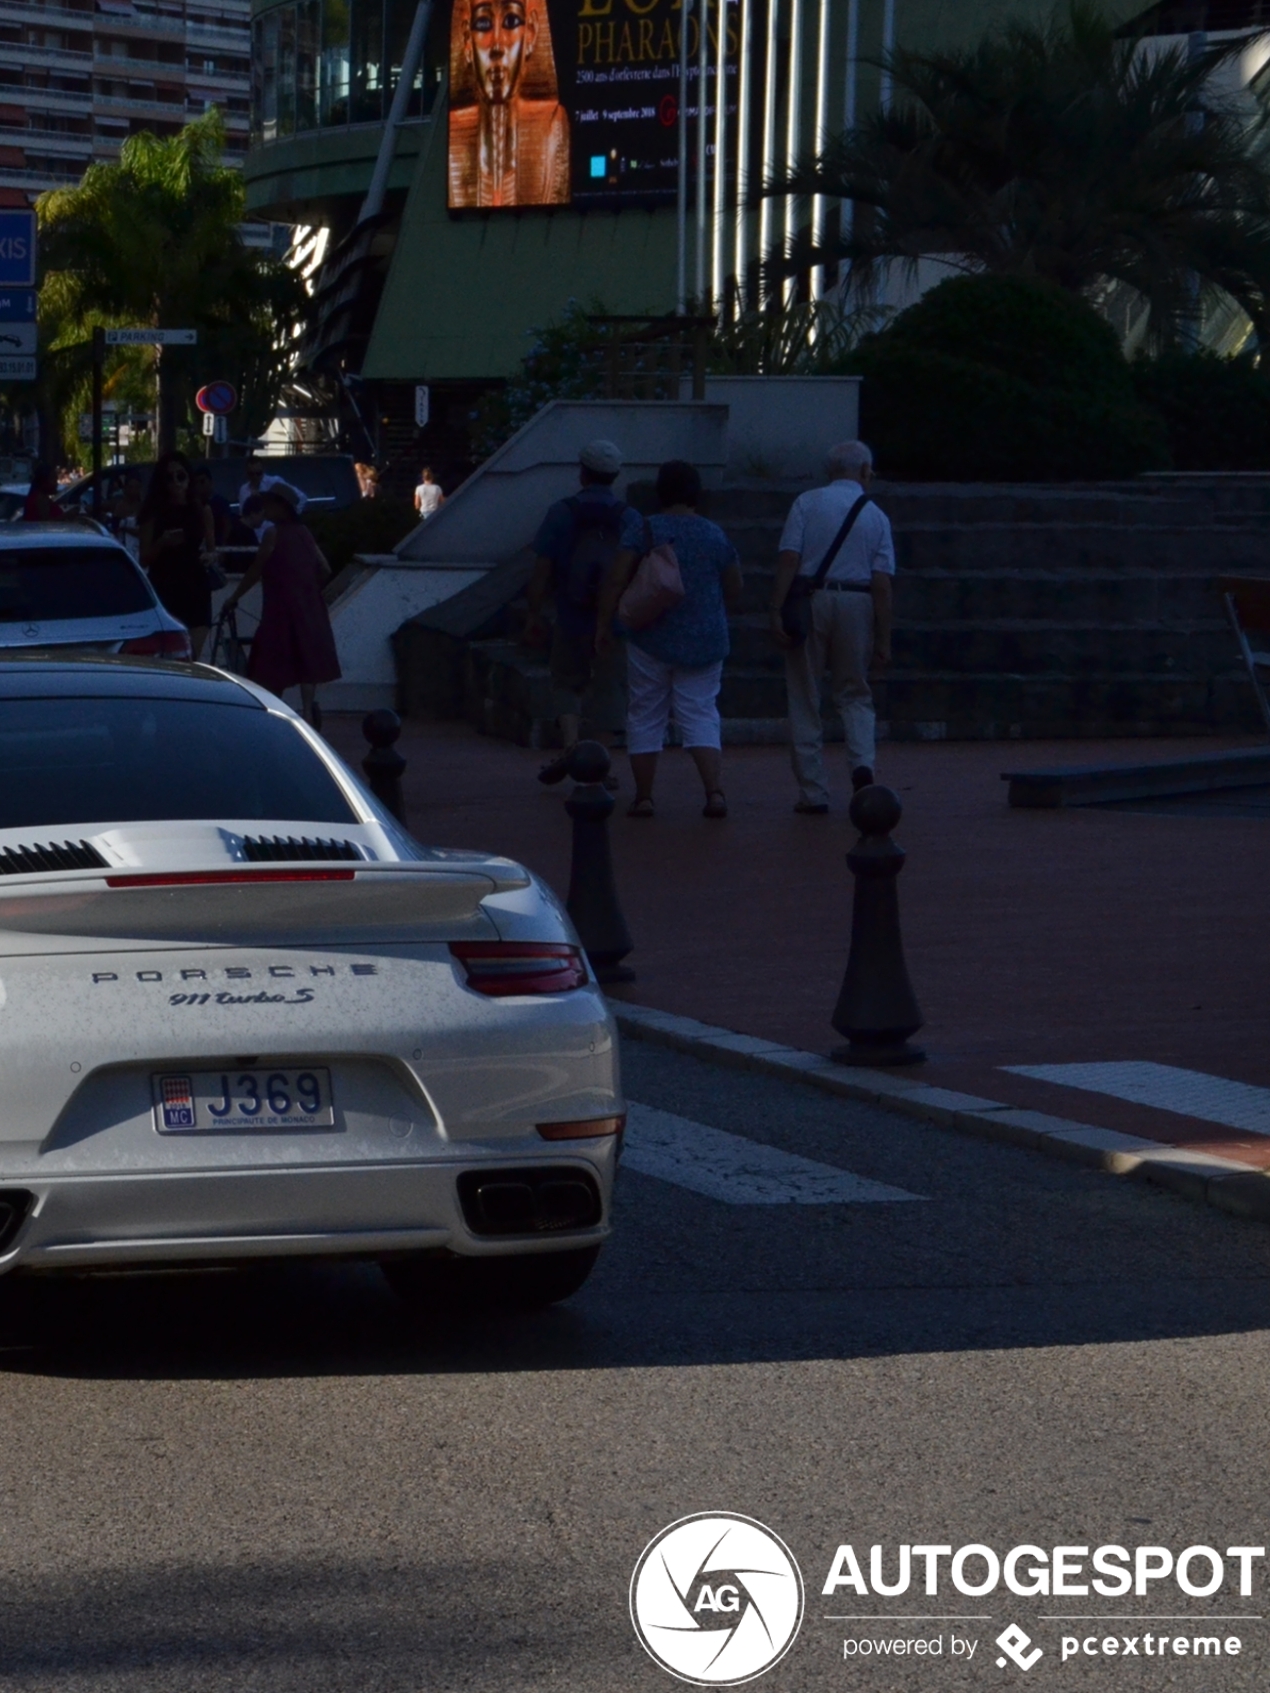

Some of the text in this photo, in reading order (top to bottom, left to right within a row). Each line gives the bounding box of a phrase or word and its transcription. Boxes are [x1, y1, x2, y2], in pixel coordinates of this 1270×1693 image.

[120, 331, 165, 342] PARKING
[92, 963, 378, 984] PORSCHE
[169, 988, 316, 1006] 911 turbo S
[206, 1073, 322, 1117] J369
[169, 1110, 189, 1125] MC
[267, 1116, 279, 1124] DE
[281, 1115, 316, 1124] MONACO
